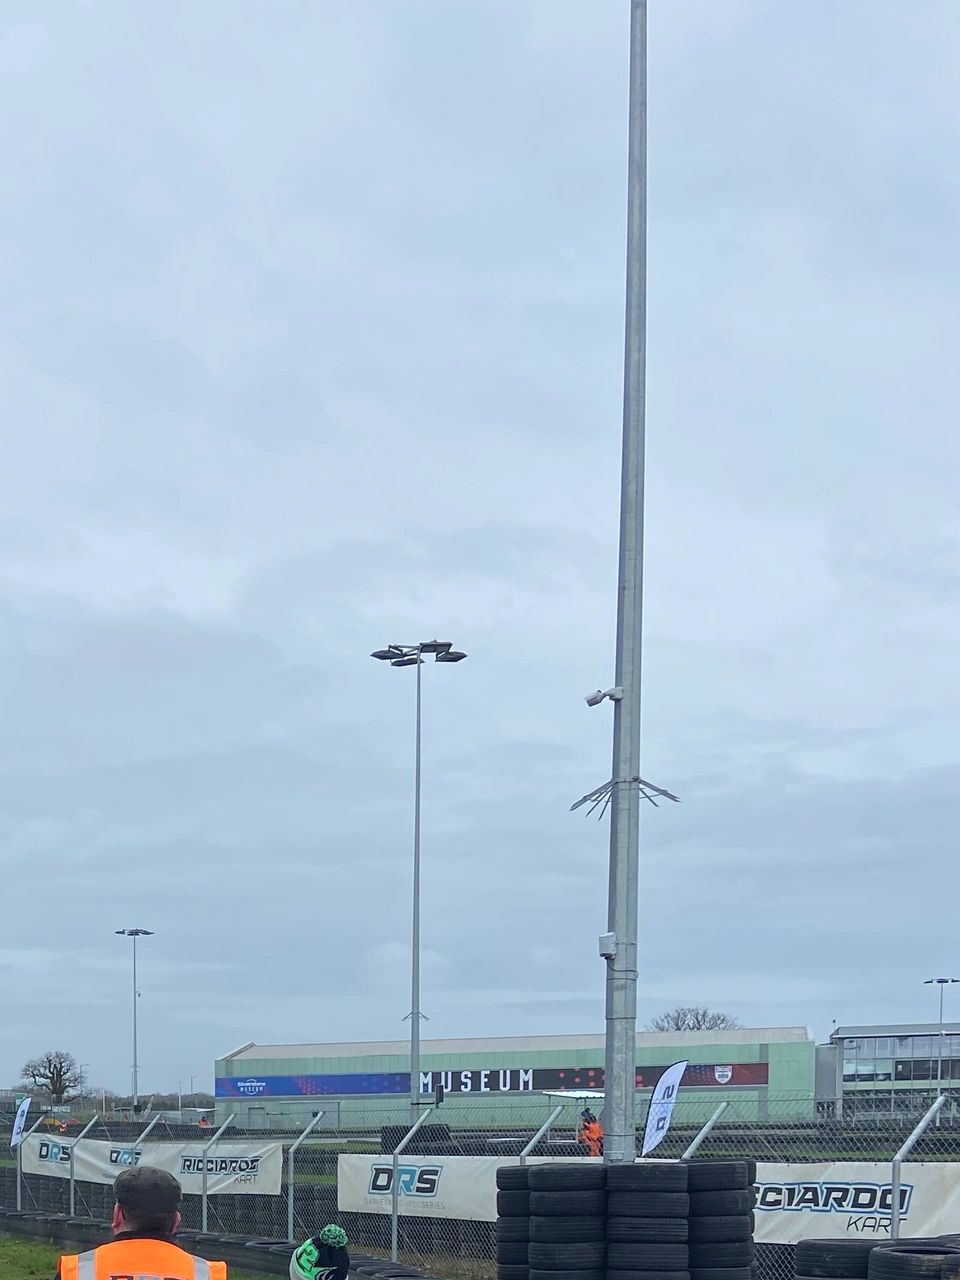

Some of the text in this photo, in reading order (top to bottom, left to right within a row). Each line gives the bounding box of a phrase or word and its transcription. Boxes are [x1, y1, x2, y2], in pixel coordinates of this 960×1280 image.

[420, 1069, 533, 1093] MUSEUM
[40, 1142, 71, 1161] DRS
[371, 1167, 440, 1194] DRS
